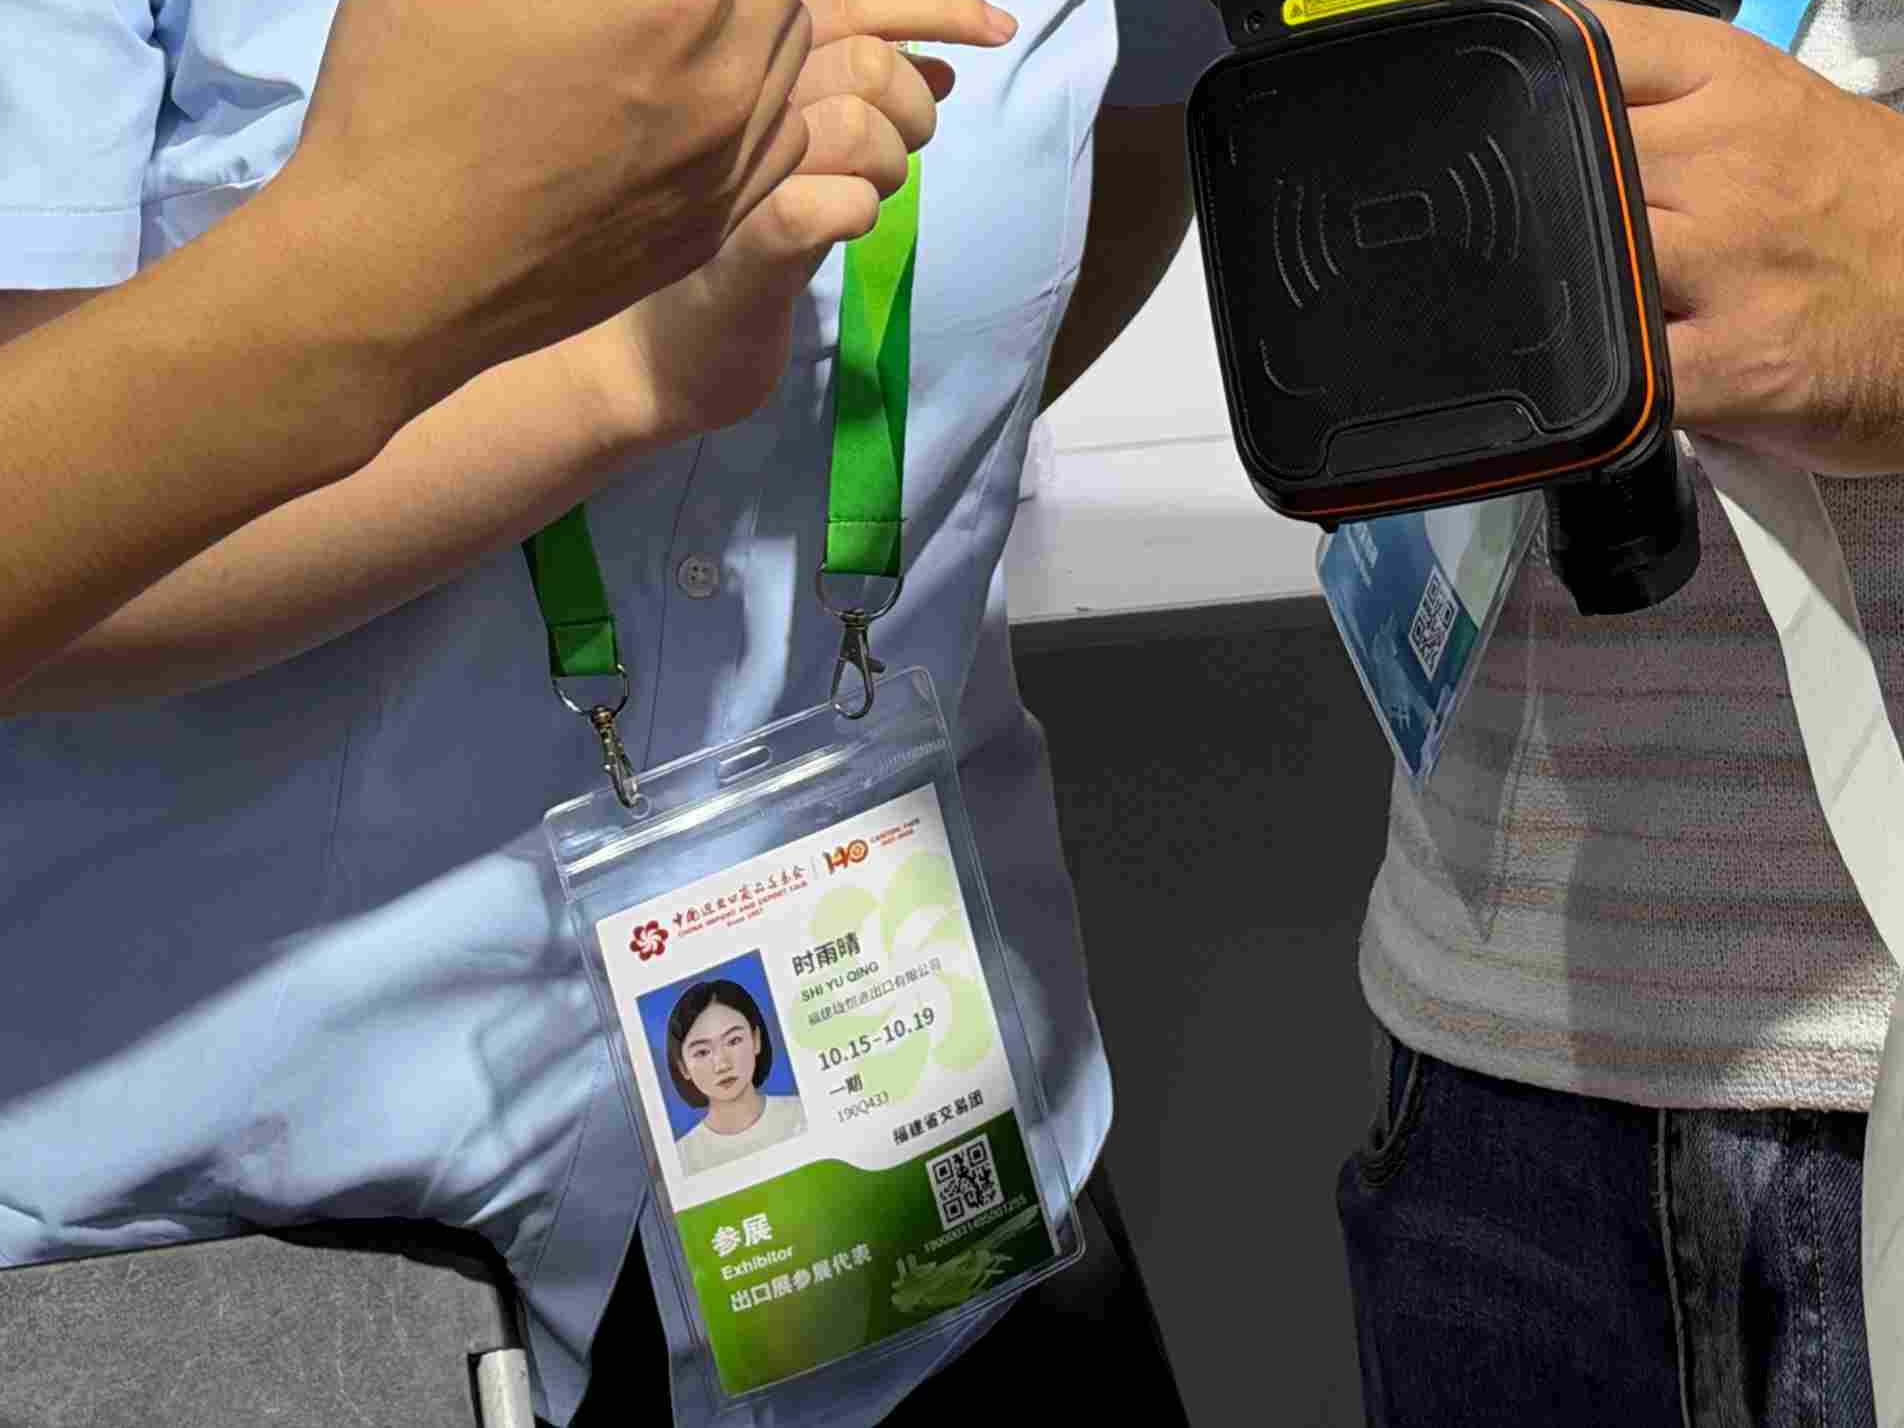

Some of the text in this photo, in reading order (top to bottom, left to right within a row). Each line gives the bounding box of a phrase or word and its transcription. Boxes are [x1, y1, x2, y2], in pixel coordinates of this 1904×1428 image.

[792, 931, 861, 976] 时雨晴
[801, 960, 879, 1002] SHI YU QING
[817, 1007, 934, 1071] 10.15-10.19
[829, 1072, 863, 1095] 一期
[712, 1211, 773, 1257] 参展
[721, 1245, 793, 1280] Exhibitor
[730, 1243, 873, 1312] 出口展参展代表
